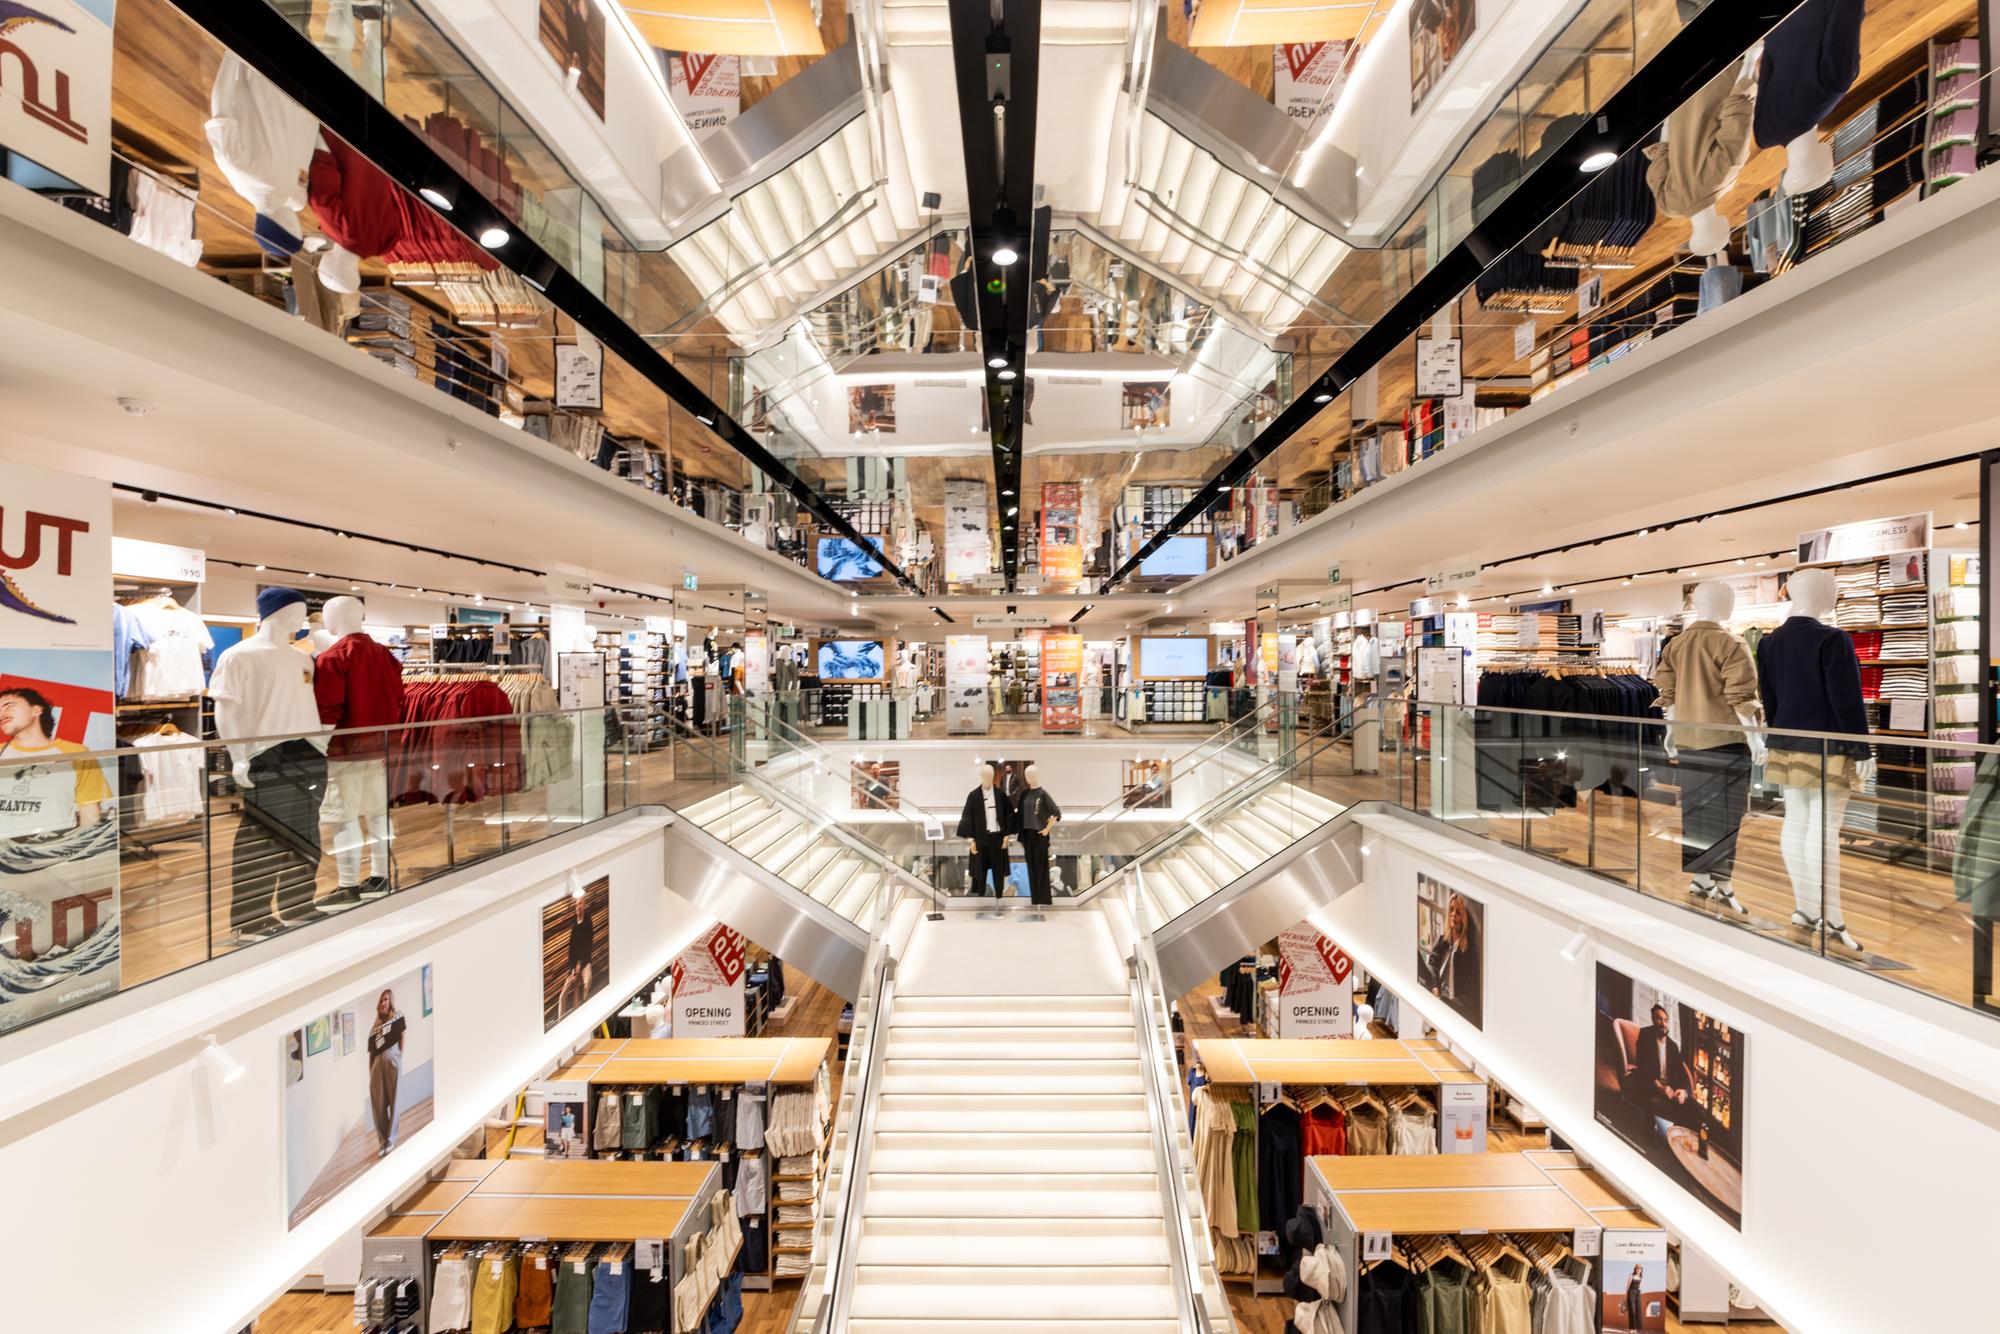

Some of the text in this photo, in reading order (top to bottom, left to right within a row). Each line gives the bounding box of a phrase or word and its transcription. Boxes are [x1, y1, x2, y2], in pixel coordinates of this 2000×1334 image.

[714, 936, 740, 976] QLO
[685, 1007, 732, 1018] OPENING
[1293, 1006, 1340, 1017] OPENING
